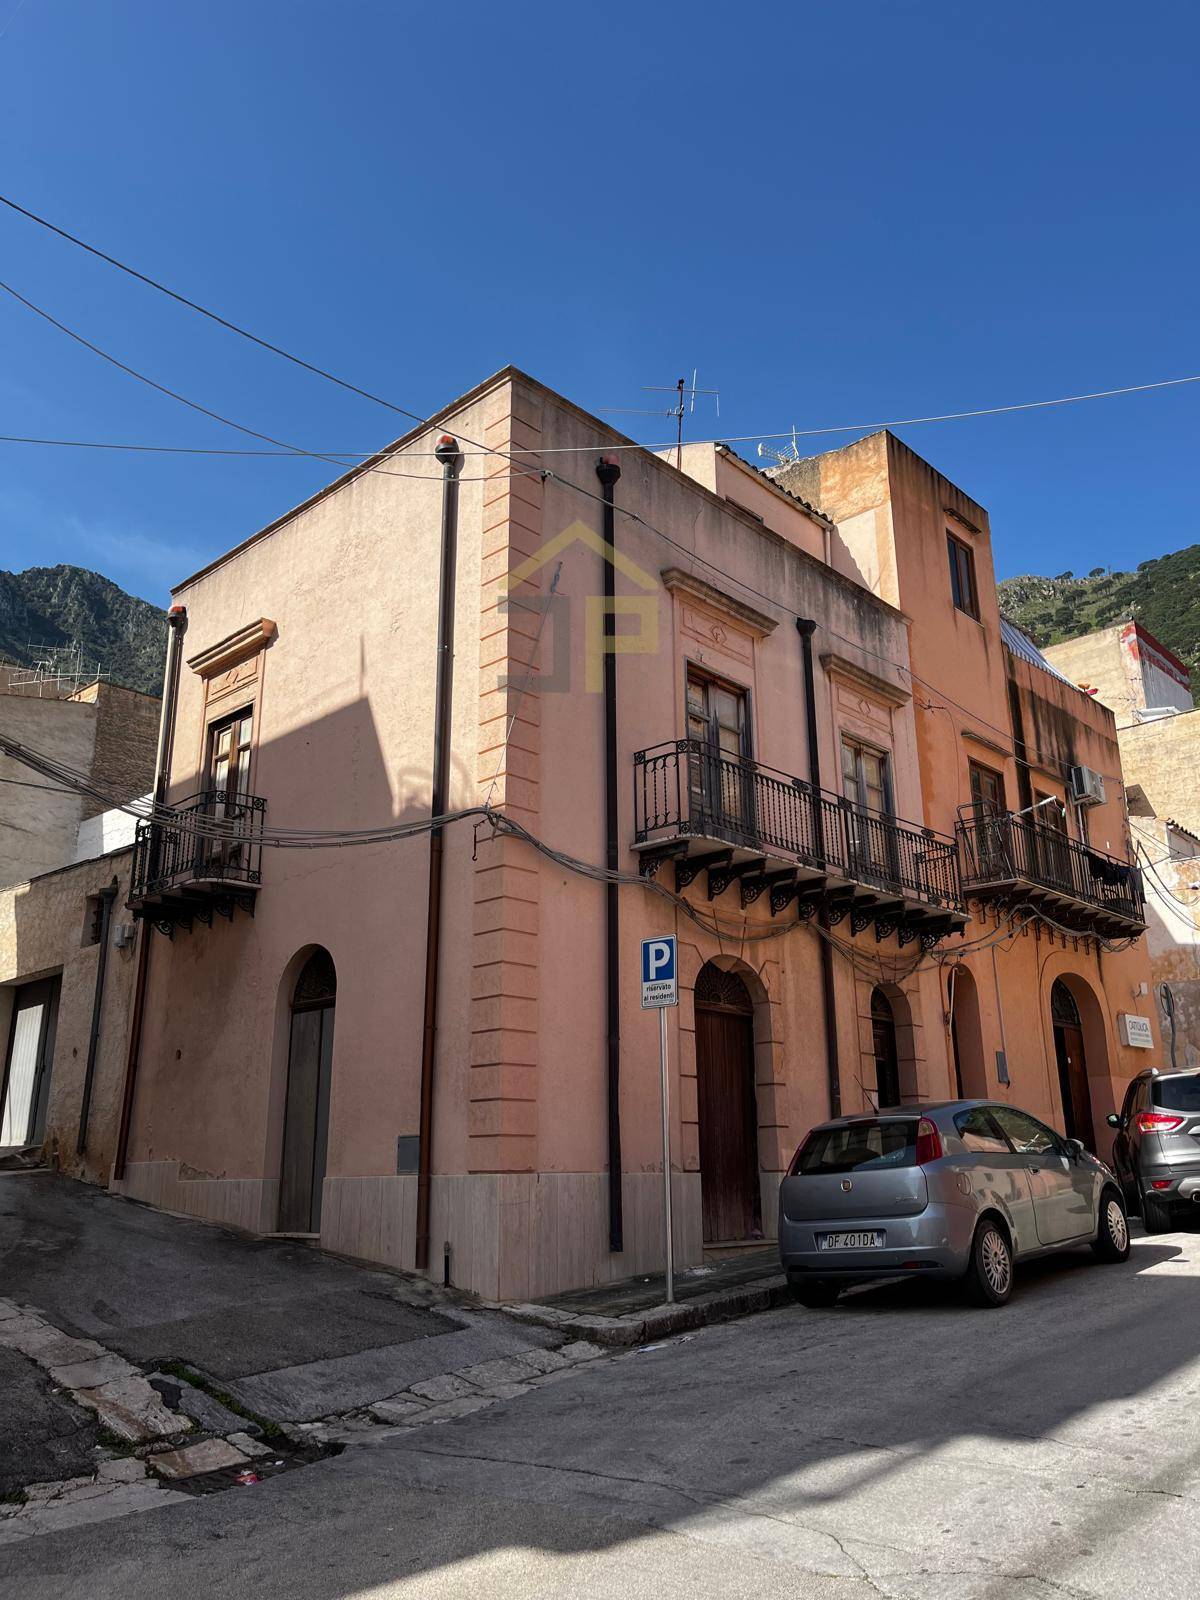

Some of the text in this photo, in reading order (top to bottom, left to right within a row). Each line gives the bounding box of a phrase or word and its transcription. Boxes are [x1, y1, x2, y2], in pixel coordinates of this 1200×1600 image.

[649, 942, 670, 980] P
[647, 983, 672, 992] riservato
[650, 992, 674, 1000] residenti
[828, 1235, 840, 1248] DF
